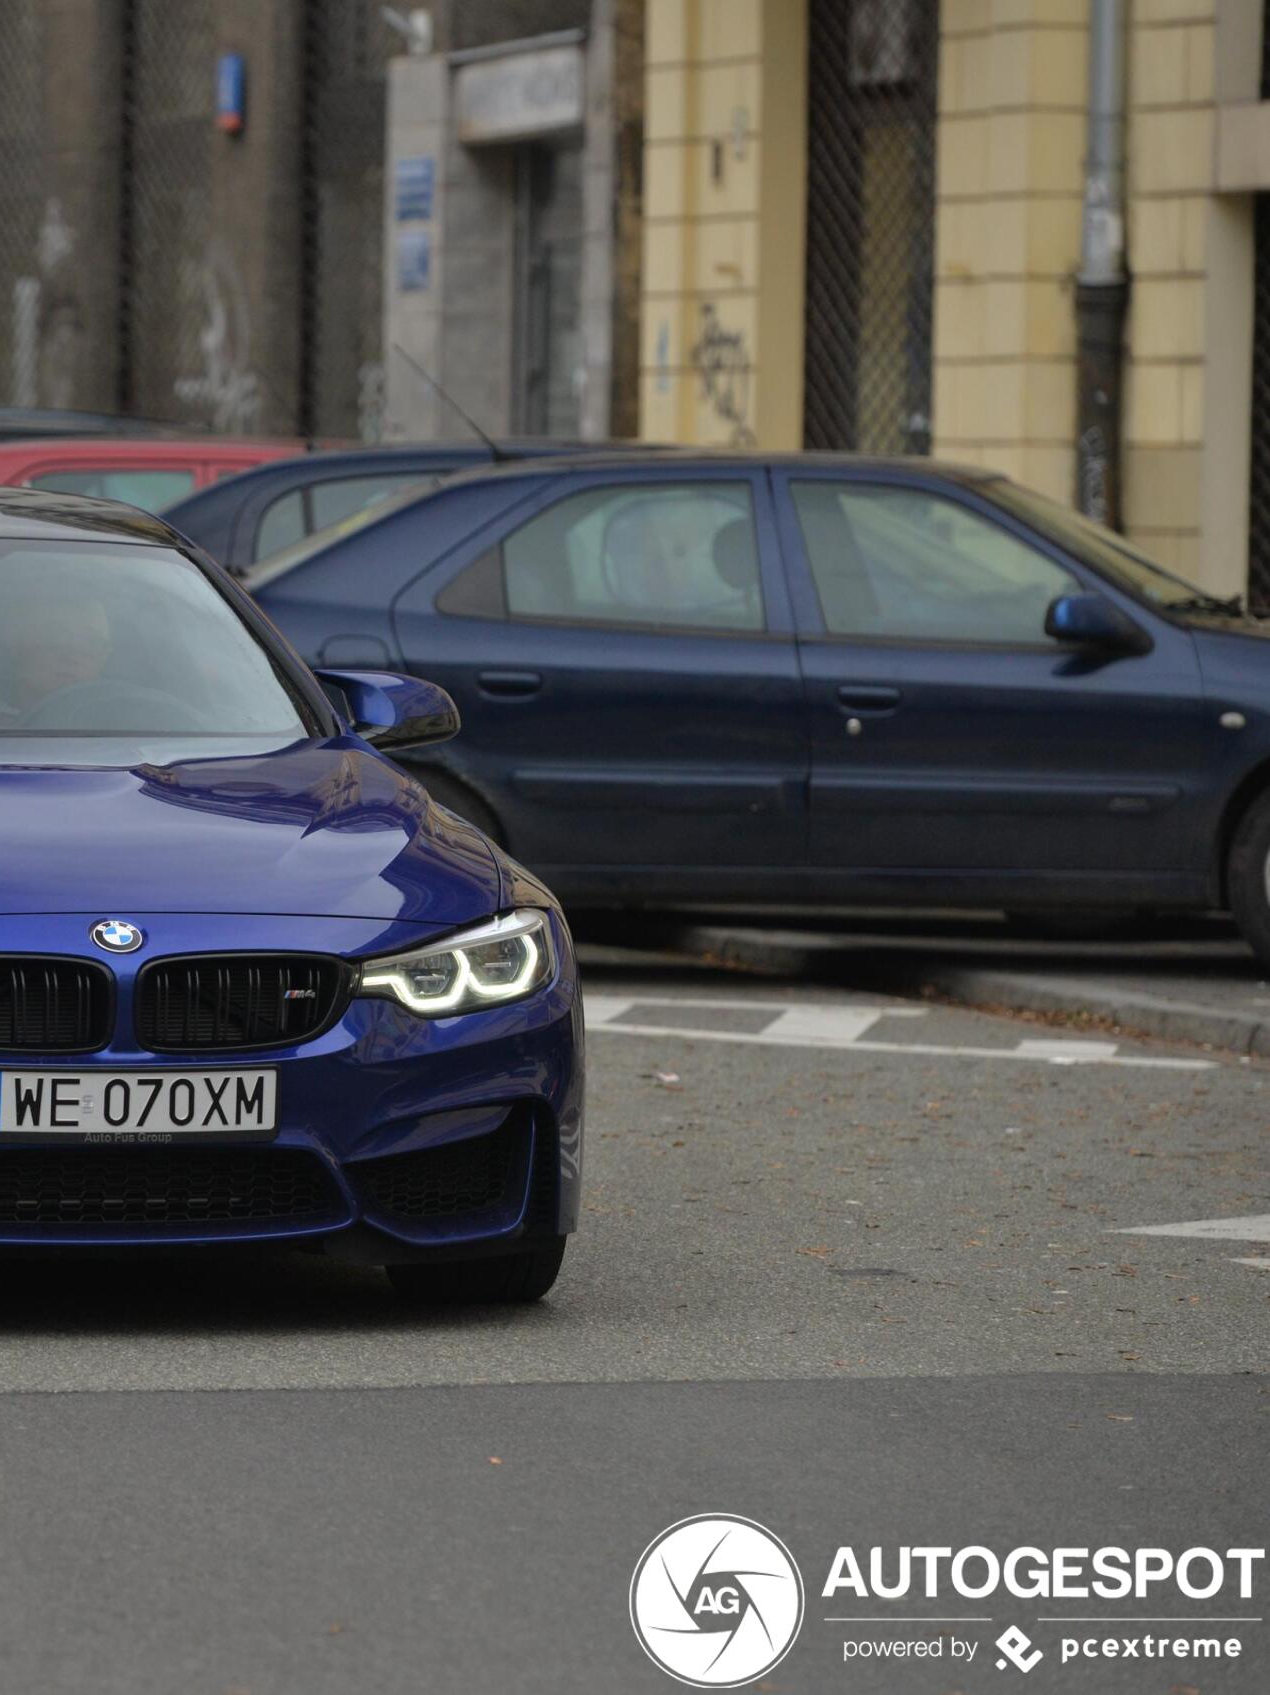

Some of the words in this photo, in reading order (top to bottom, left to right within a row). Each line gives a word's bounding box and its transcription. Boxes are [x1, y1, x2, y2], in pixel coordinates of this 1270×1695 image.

[292, 989, 316, 999] M4
[14, 1077, 81, 1127] WE
[103, 1076, 265, 1127] 070XM
[84, 1132, 112, 1143] Auto
[115, 1132, 135, 1143] Fus
[138, 1132, 172, 1145] Group
